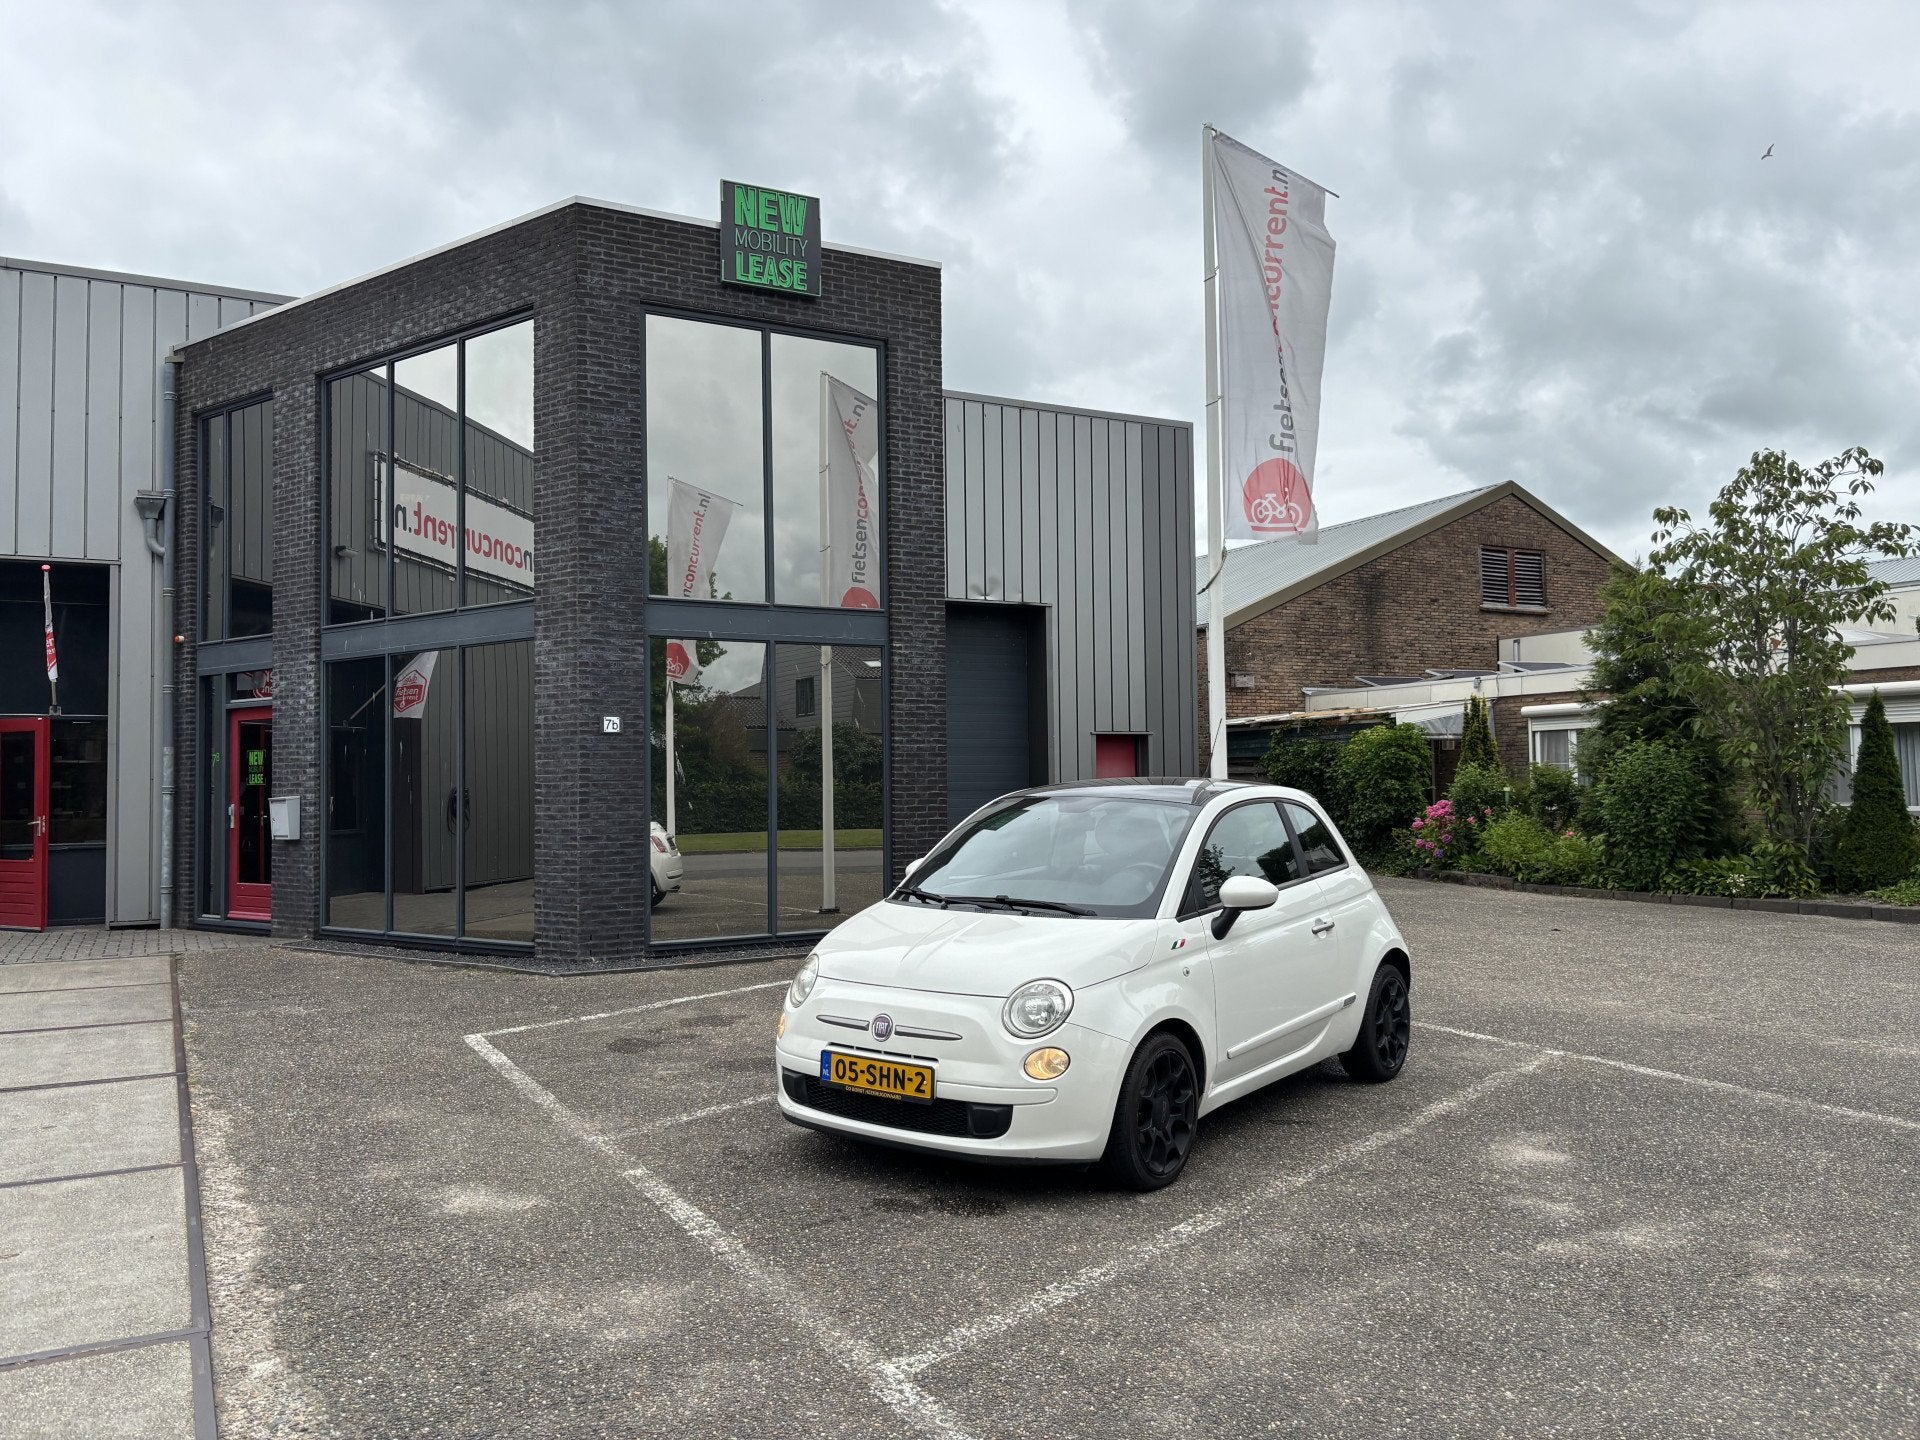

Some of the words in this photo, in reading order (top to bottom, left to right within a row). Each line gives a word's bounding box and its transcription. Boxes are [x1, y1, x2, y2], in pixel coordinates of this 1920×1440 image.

[734, 184, 808, 236] NEW
[735, 227, 808, 257] MOBILITY
[735, 250, 808, 290] LEASE
[1263, 169, 1295, 453] fietscurrent.n
[605, 719, 619, 730] 7b
[248, 751, 264, 766] NEW
[248, 773, 264, 784] LEASE
[875, 1021, 889, 1034] FIAT
[822, 1068, 830, 1076] NL
[834, 1058, 926, 1094] 05-SHN-2
